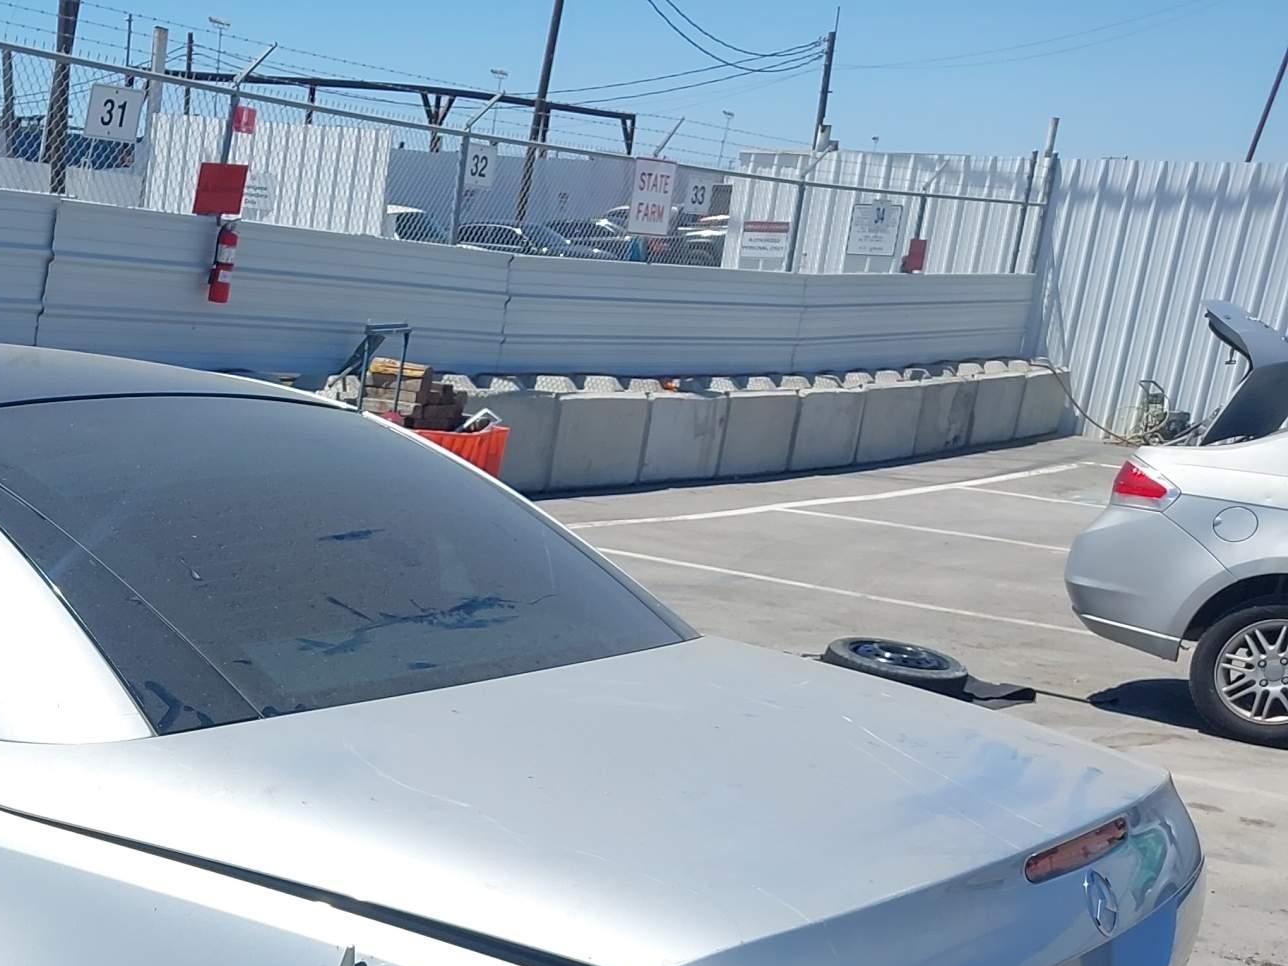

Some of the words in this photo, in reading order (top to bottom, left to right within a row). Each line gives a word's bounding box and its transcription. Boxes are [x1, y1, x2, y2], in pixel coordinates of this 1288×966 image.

[100, 98, 128, 128] 31
[470, 153, 489, 178] 32
[639, 171, 671, 194] STATE
[690, 185, 706, 205] 33
[636, 201, 665, 223] FARM
